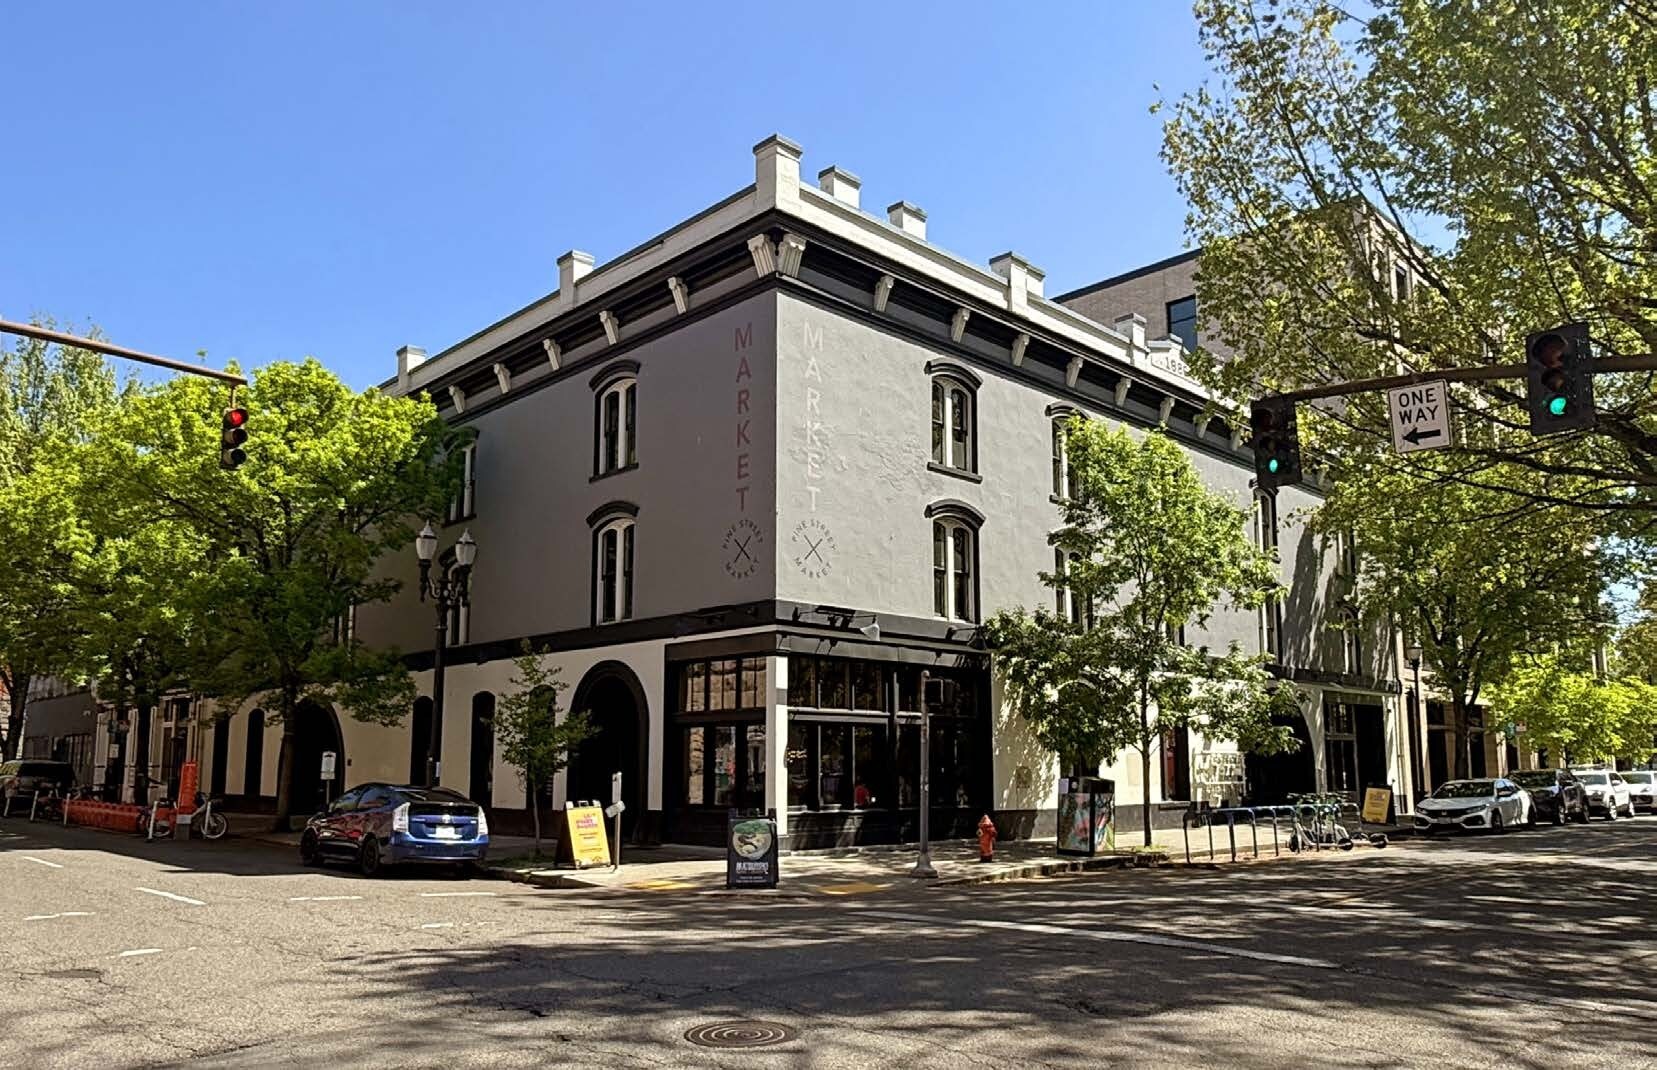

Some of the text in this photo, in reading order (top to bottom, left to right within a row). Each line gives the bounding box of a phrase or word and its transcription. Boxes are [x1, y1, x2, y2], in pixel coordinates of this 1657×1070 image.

[1398, 387, 1437, 408] ONE
[734, 322, 753, 512] MARKET
[803, 318, 824, 512] MARKET
[1398, 404, 1439, 425] WAY
[722, 519, 763, 550] PINE STREET
[791, 519, 837, 551] PINE STREET
[725, 556, 760, 579] MARKET
[794, 556, 832, 579] MARKET
